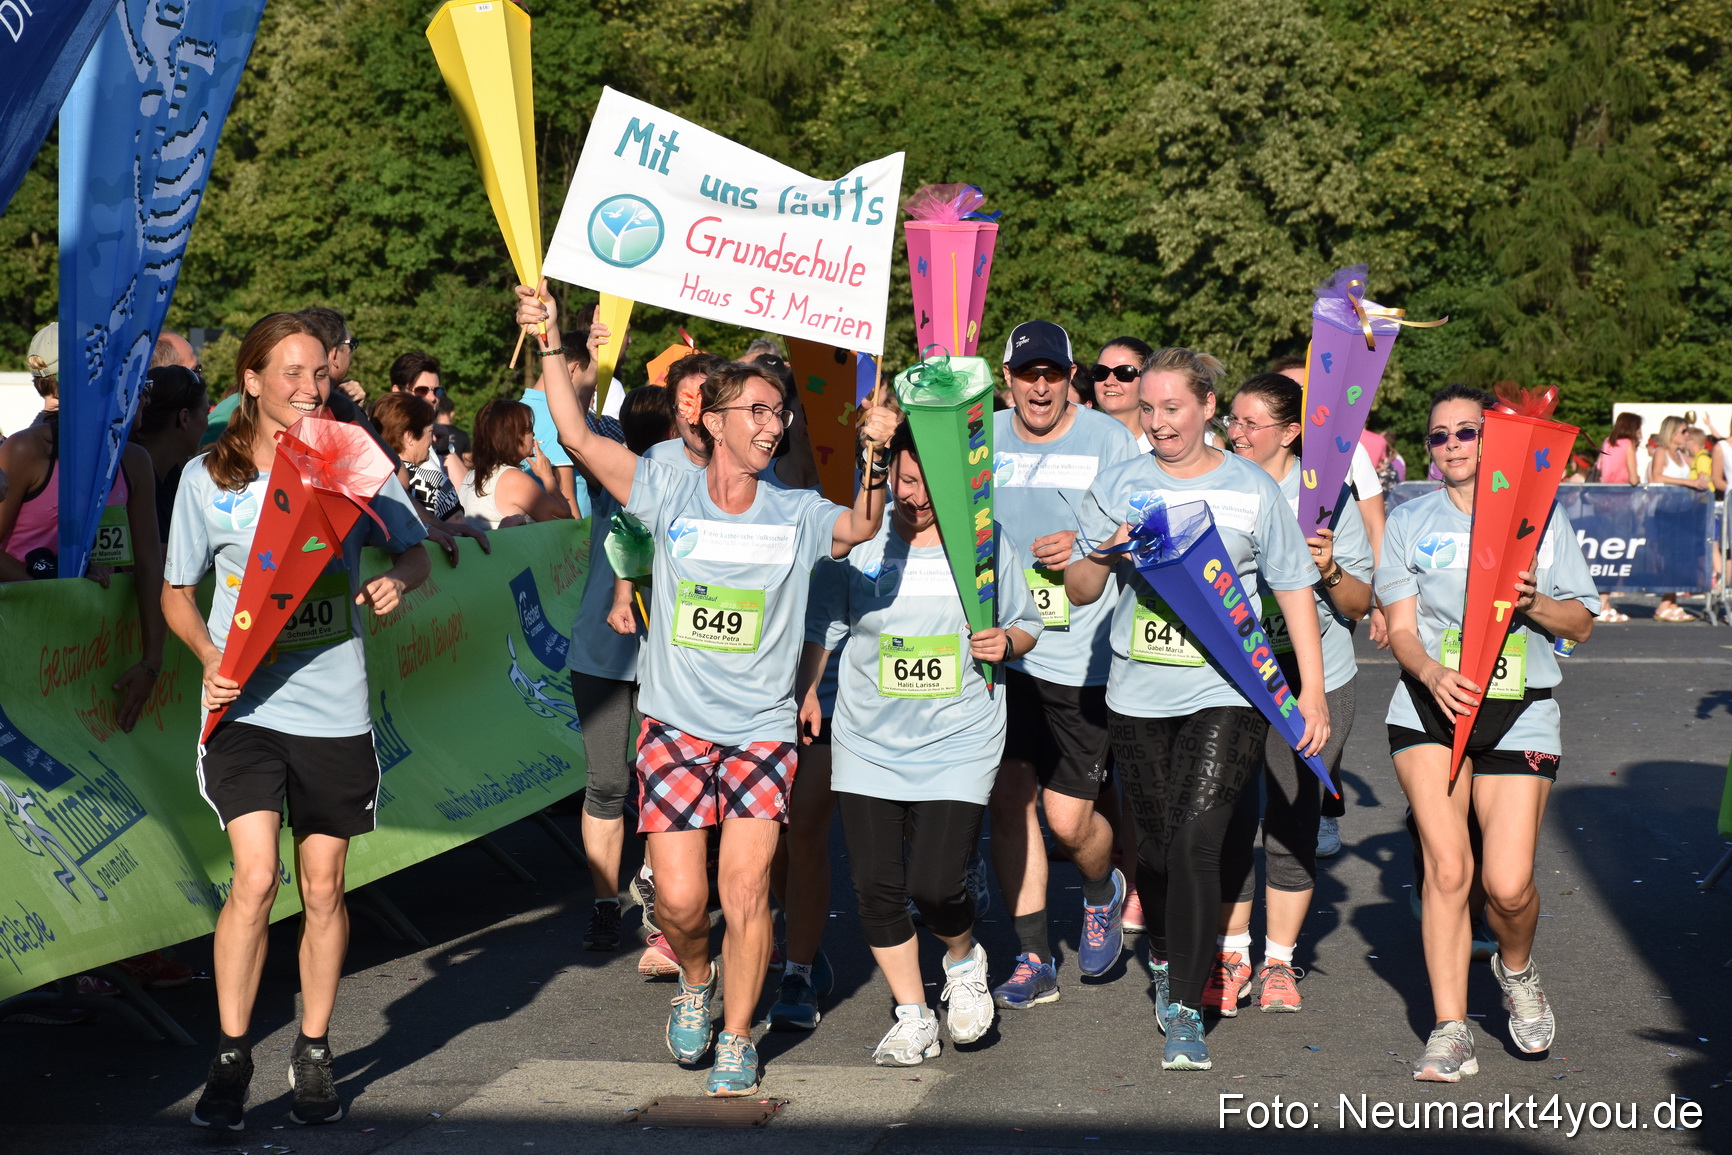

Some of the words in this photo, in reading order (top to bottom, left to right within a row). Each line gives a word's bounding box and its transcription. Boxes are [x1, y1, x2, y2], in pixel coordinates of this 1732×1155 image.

[614, 117, 680, 175] Mit
[700, 174, 758, 210] uns
[778, 176, 884, 225] läufts
[685, 216, 866, 287] Grundschule
[679, 273, 732, 307] Haus
[745, 287, 776, 319] St.
[782, 293, 873, 340] Marien
[967, 402, 988, 465] HAUS
[974, 508, 995, 604] MARIEN
[287, 629, 317, 639] Schmidt
[692, 607, 743, 635] 649
[692, 630, 721, 641] Piszczor
[722, 634, 740, 642] Petra
[1144, 620, 1187, 646] 641
[1203, 558, 1298, 719] GRUNDSCHULE
[894, 658, 942, 681] 646
[96, 842, 139, 889] neumarkt
